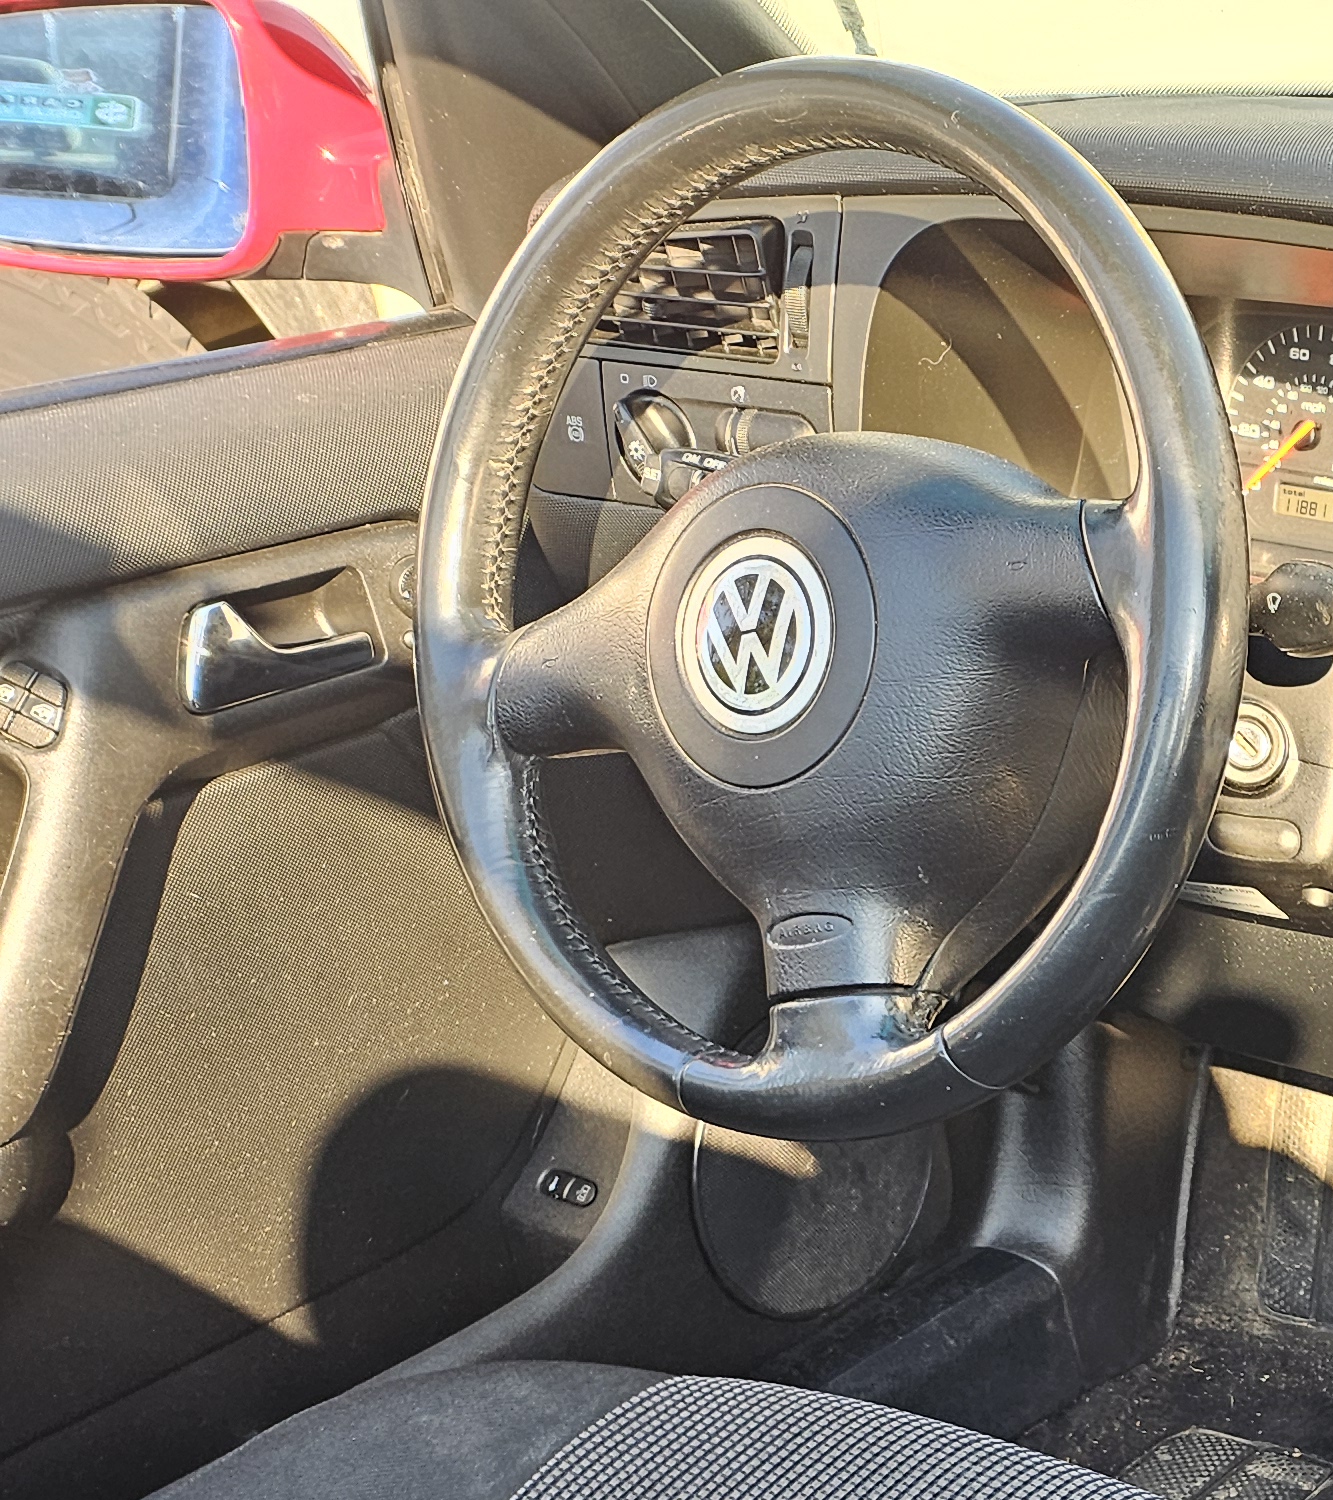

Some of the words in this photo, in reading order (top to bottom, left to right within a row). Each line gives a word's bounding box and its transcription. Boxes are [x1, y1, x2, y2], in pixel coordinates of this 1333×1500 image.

[1289, 349, 1310, 362] 60
[566, 415, 583, 427] ABS
[682, 452, 702, 466] ON
[643, 466, 661, 481] SET
[778, 920, 835, 940] AIRBAG
